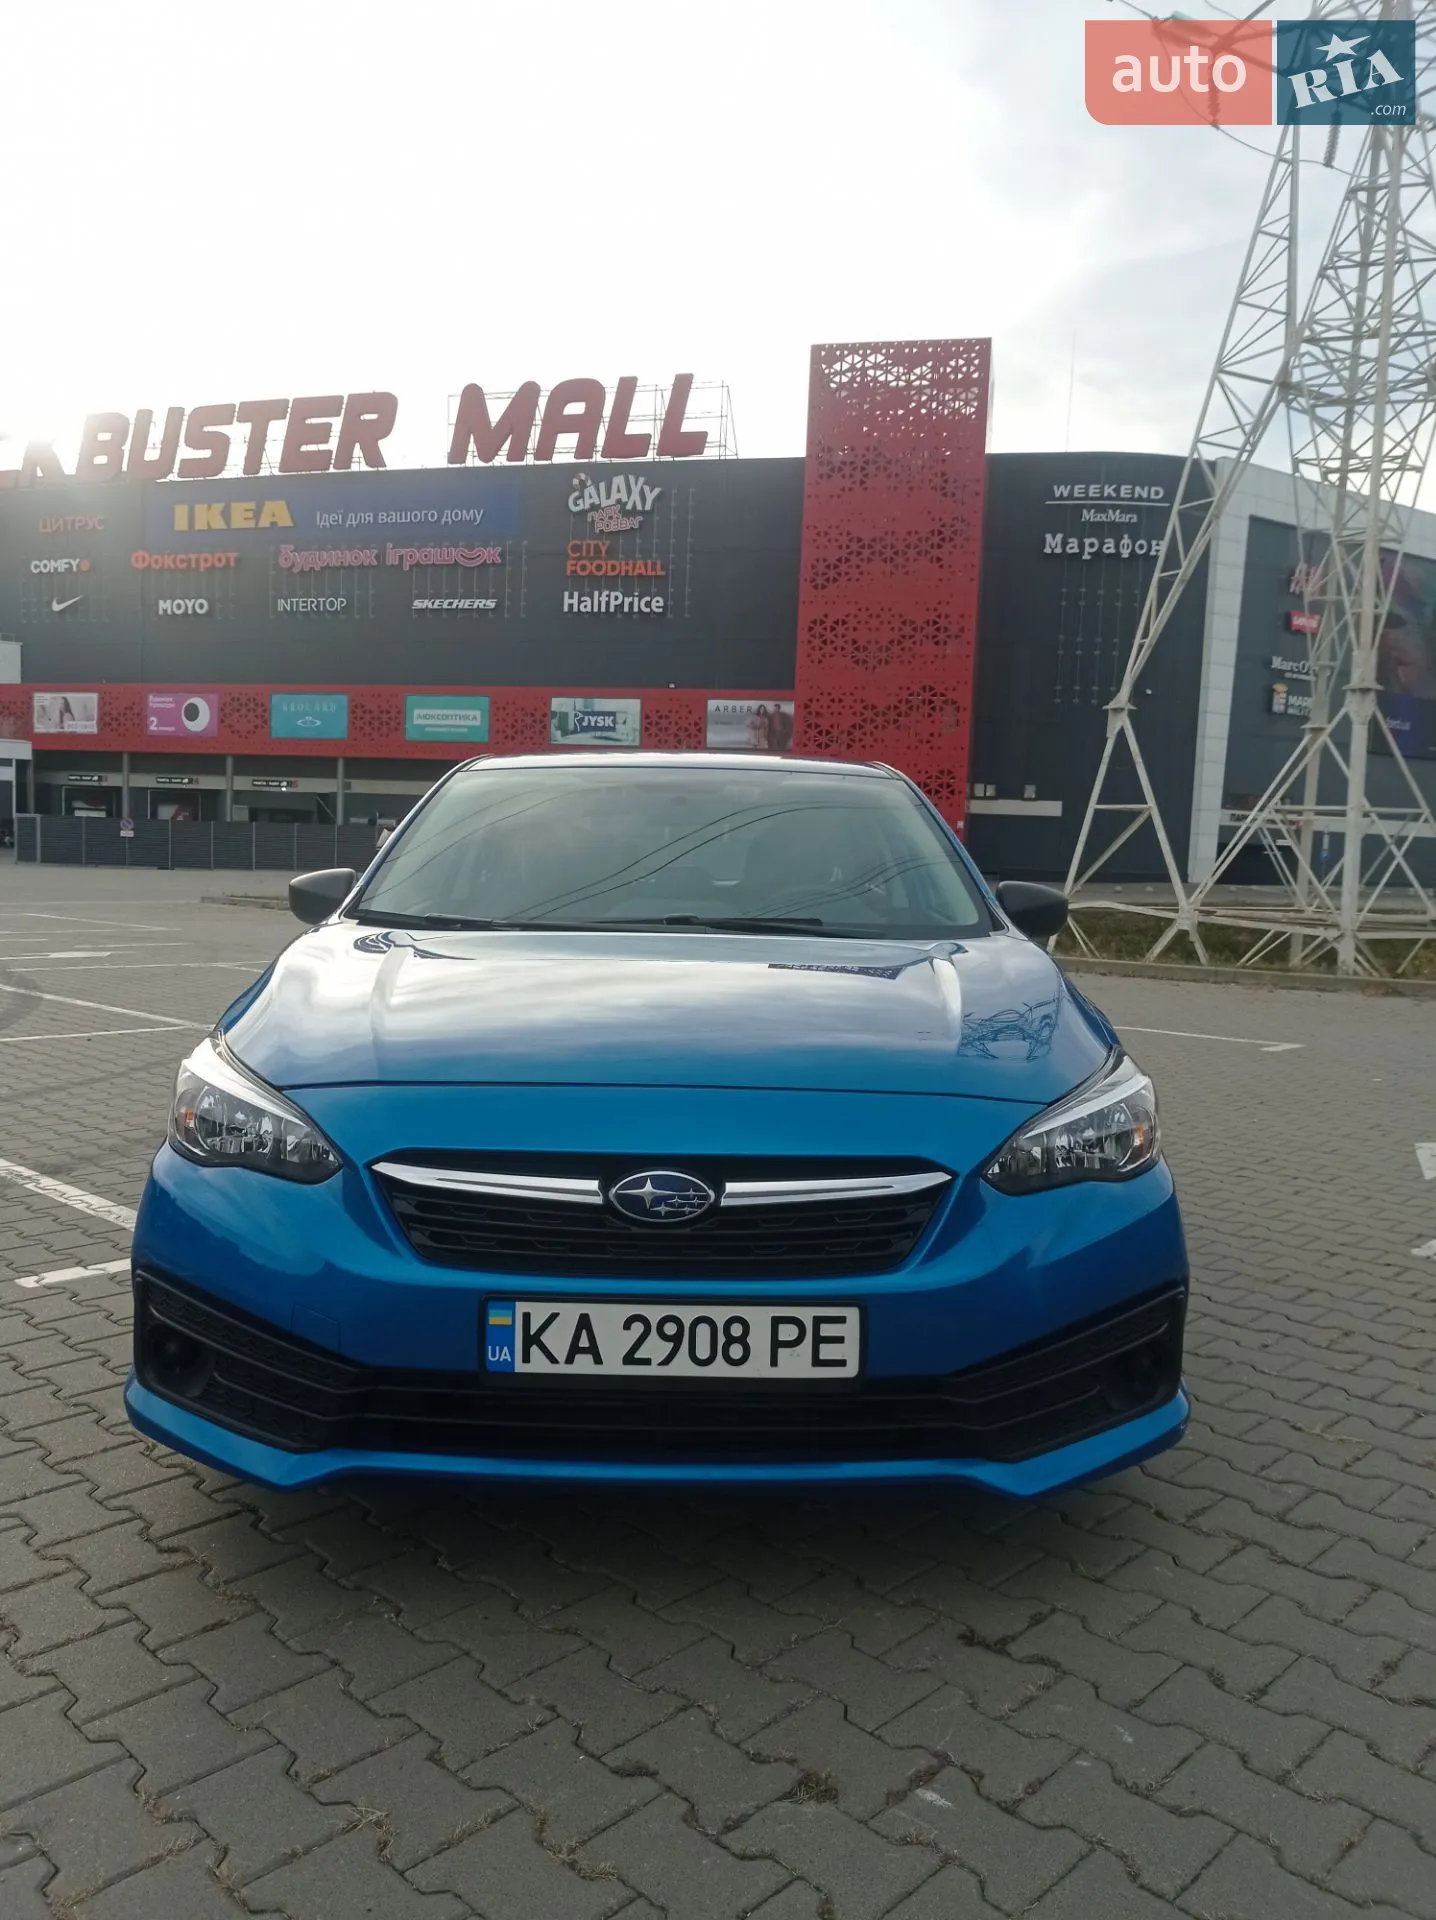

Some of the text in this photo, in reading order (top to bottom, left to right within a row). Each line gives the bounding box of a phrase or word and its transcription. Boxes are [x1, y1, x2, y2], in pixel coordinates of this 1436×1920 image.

[448, 373, 708, 464] MALL
[568, 474, 662, 512] GALAXY
[1053, 485, 1164, 499] WEEKEND
[174, 500, 294, 531] IKEA
[317, 508, 483, 527] Ідеї для вашого дому
[1081, 509, 1137, 522] MaxMara
[39, 515, 105, 533] ЦИТРУС
[567, 541, 610, 557] CITY
[1043, 533, 1165, 559] Марафон
[30, 559, 80, 573] COMFY
[131, 551, 239, 572] Фокстрот
[566, 560, 666, 576] FOODHALL
[158, 599, 209, 615] MOYO
[277, 598, 346, 612] INTERTOP
[412, 598, 498, 609] SKECHERS
[563, 590, 664, 612] HalfPrice
[715, 705, 752, 713] ARBER
[582, 715, 614, 727] JYSK
[521, 1311, 848, 1367] KA 2908 PE
[488, 1346, 511, 1362] UA
